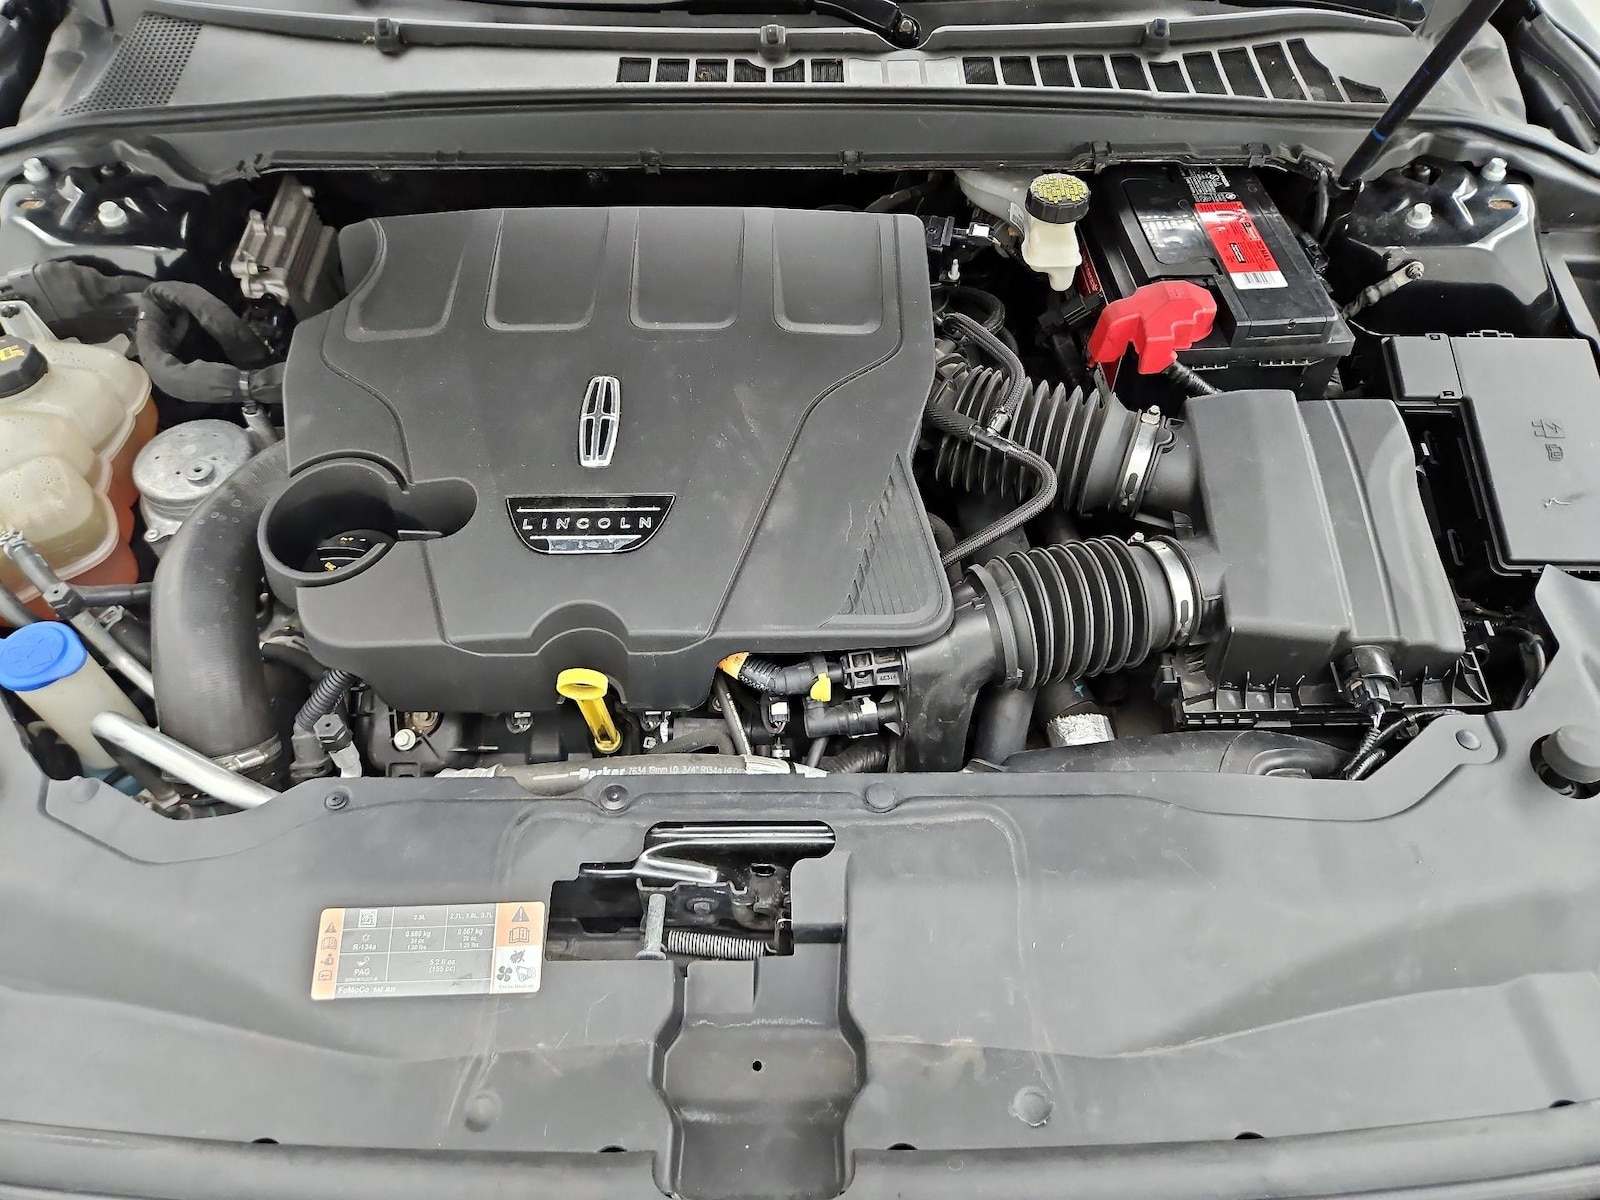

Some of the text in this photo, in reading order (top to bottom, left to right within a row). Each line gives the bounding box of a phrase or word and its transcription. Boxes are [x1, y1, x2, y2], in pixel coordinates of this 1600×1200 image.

[522, 517, 652, 529] LINCOLN
[423, 929, 431, 938] kg
[475, 927, 483, 935] kg
[353, 943, 377, 951] R-134a
[354, 968, 371, 976] PAG
[338, 985, 370, 993] FoMoCo
